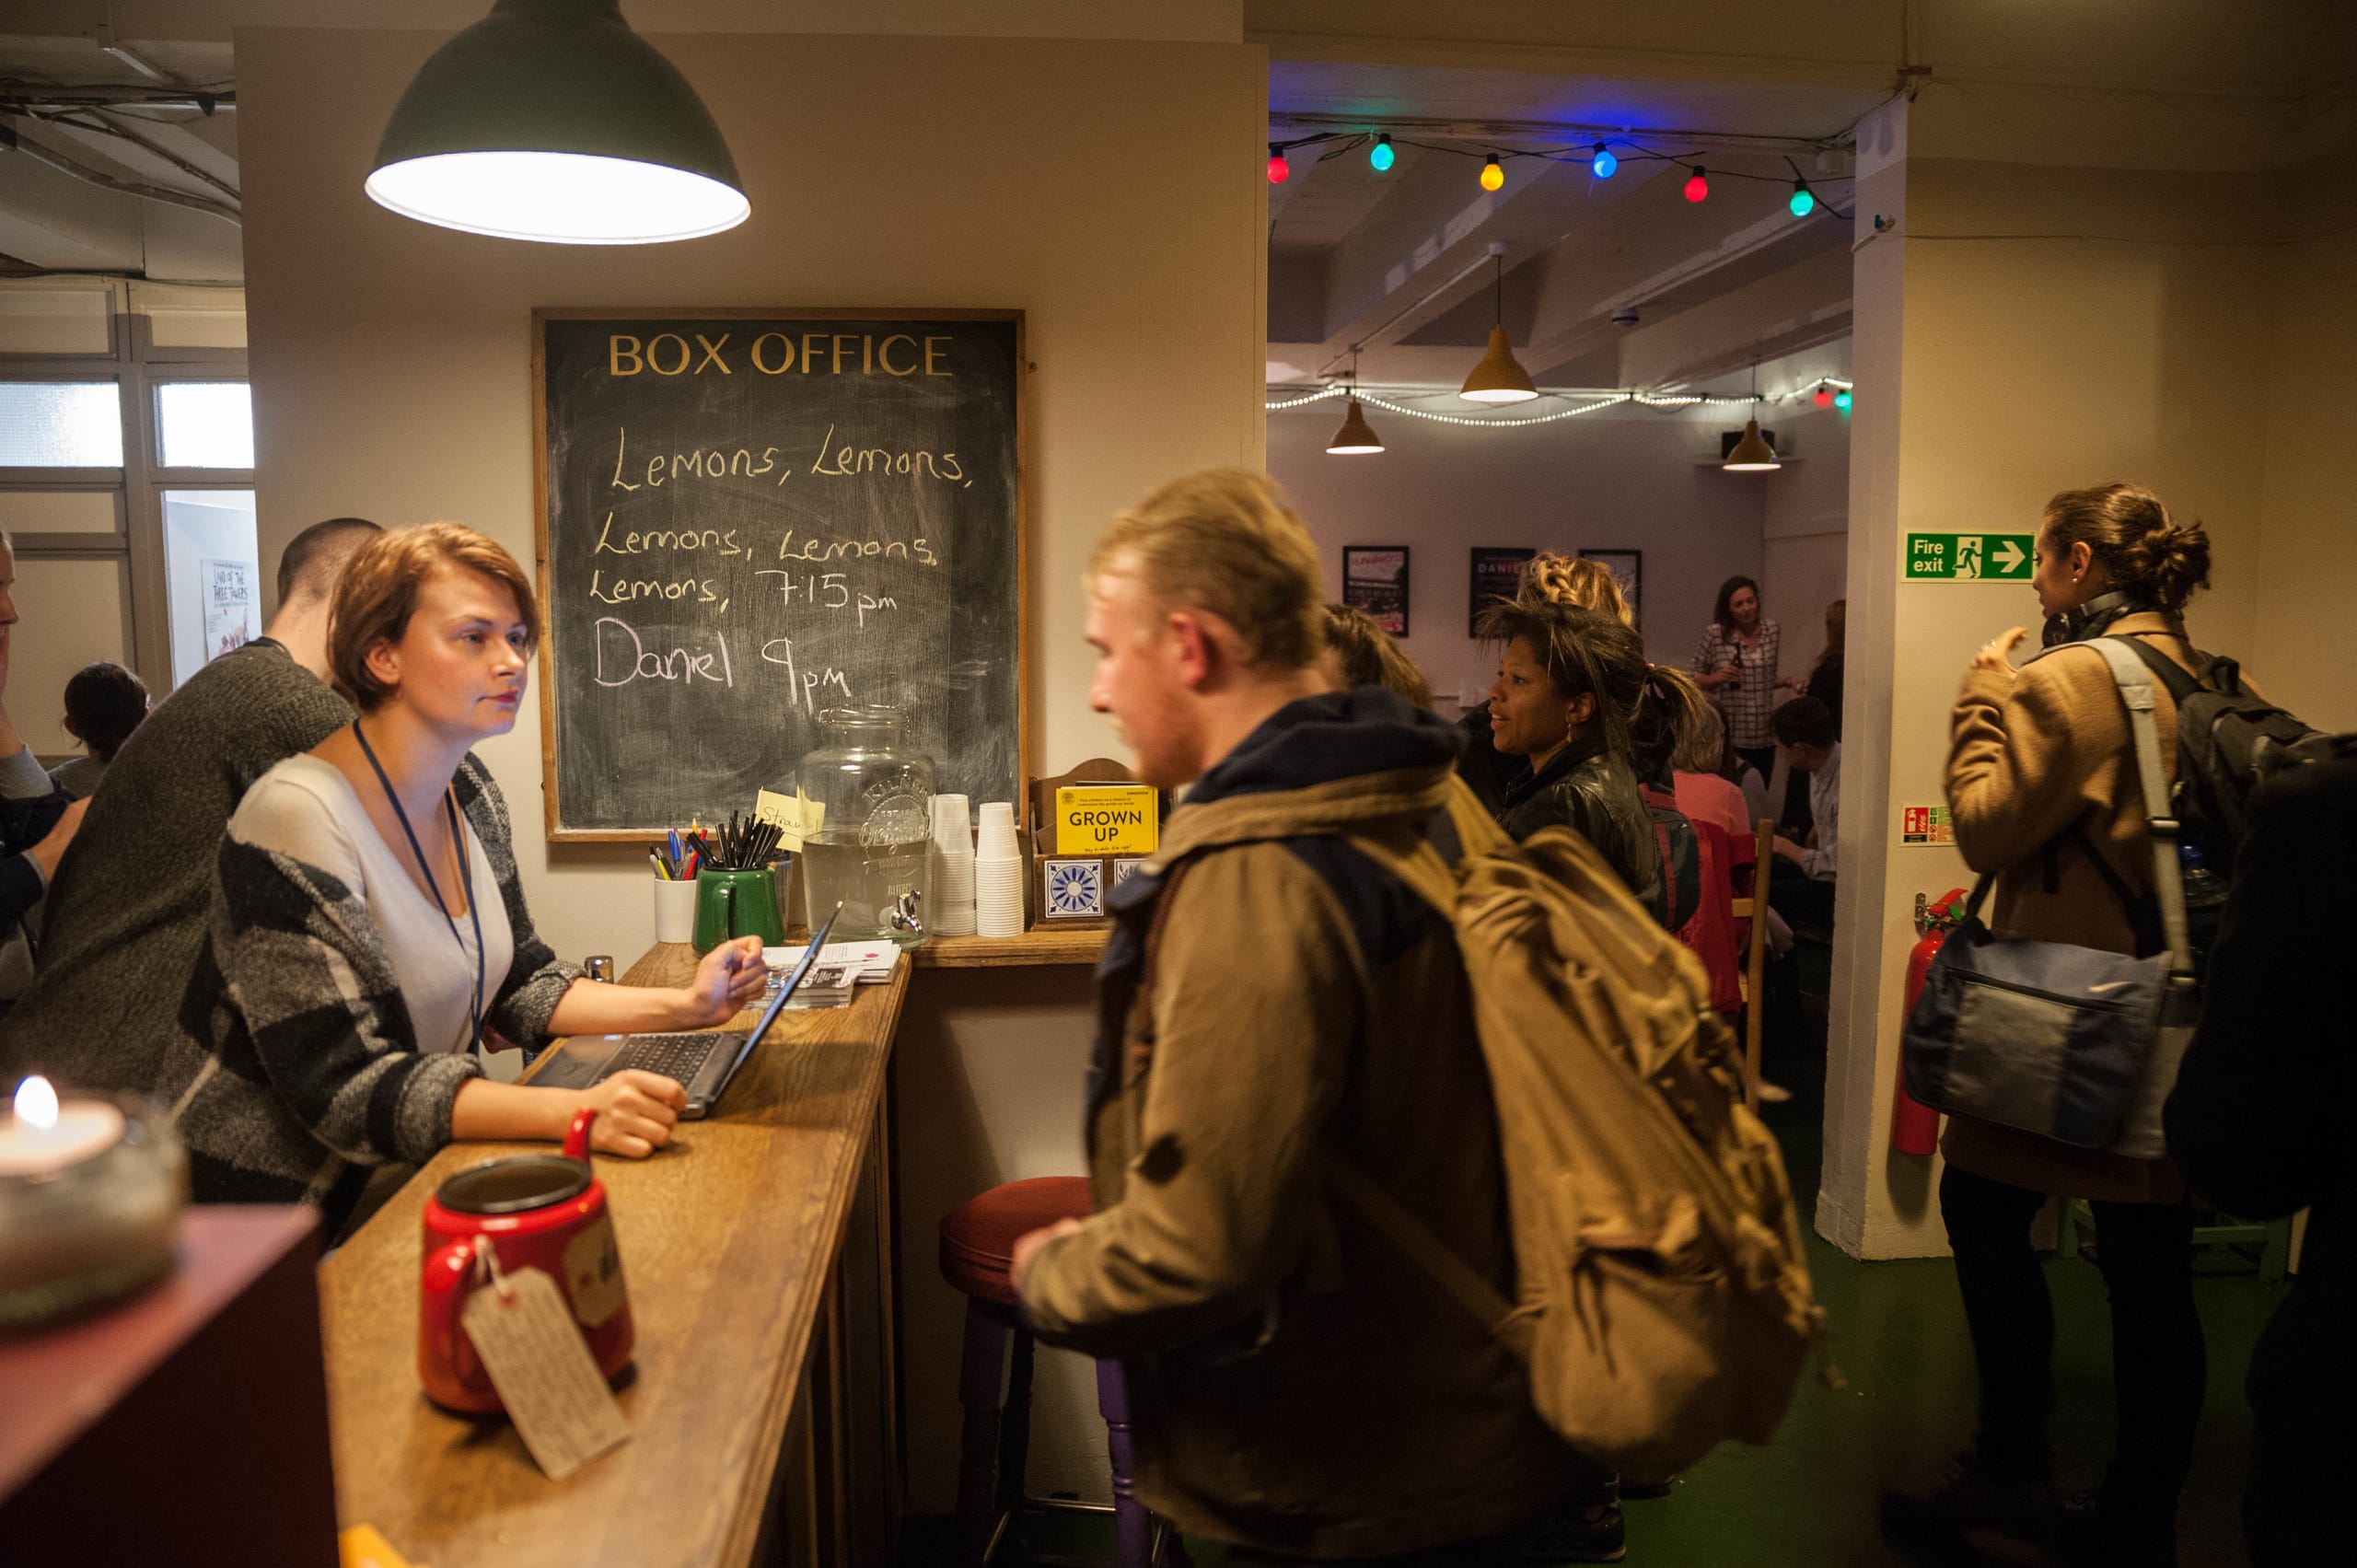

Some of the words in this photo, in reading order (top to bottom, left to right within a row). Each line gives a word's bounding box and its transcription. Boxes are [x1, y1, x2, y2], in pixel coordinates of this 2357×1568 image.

[610, 332, 733, 377] BOX
[750, 332, 954, 377] OFFICE
[611, 426, 791, 492] Lemons,
[811, 423, 973, 489] Lemons,
[595, 511, 752, 561] Lemons,
[1913, 539, 1945, 554] Fire
[1478, 563, 1523, 575] DANIE
[1913, 557, 1945, 572] exit
[589, 569, 729, 614] Lemons,
[594, 616, 734, 689] Daniel
[1069, 810, 1143, 827] GROWN
[1094, 827, 1119, 842] UP
